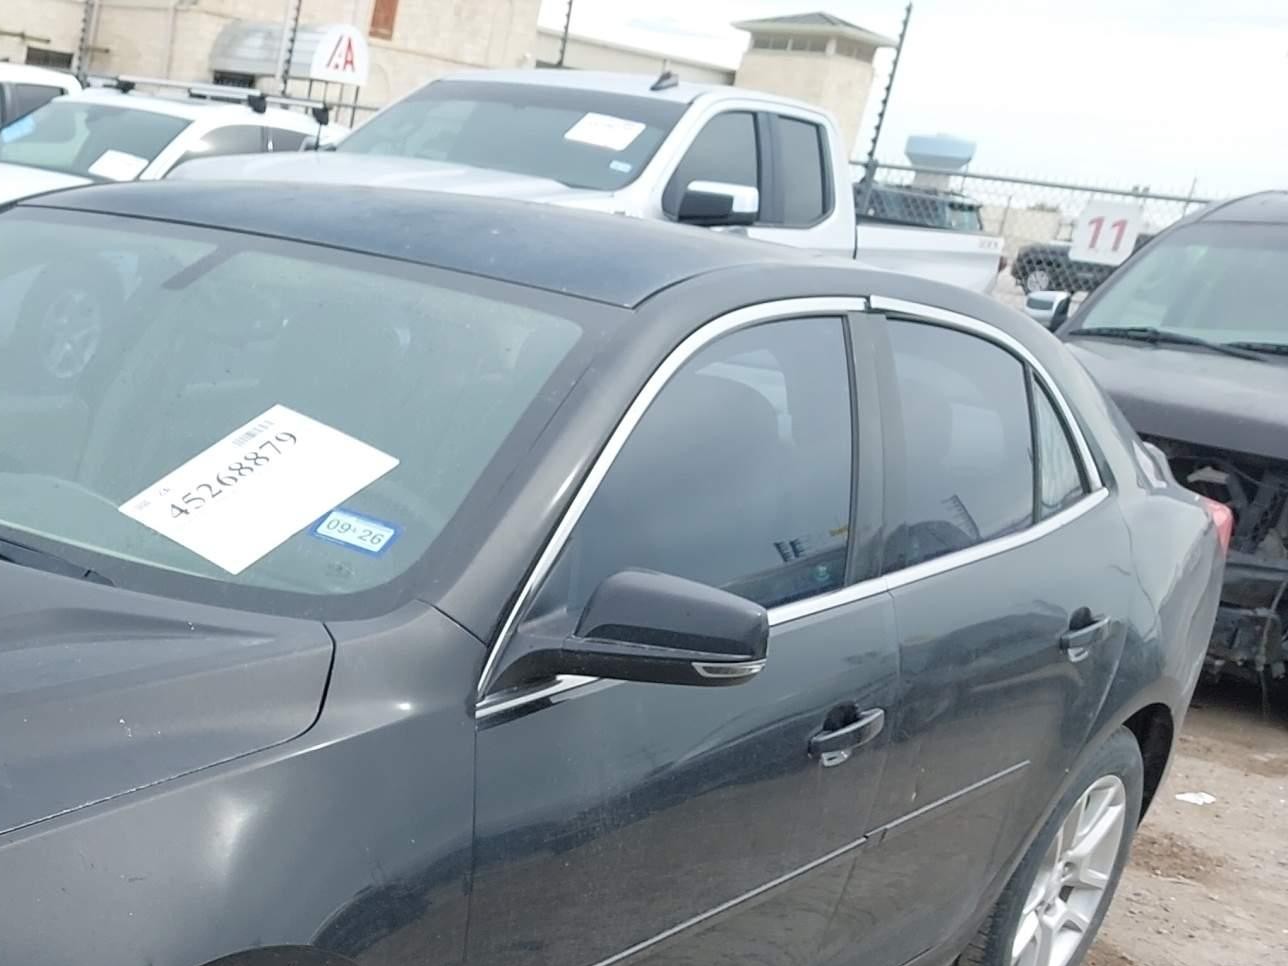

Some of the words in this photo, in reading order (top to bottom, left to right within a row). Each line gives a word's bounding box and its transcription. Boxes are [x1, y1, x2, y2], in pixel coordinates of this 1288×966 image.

[1088, 215, 1128, 252] 11
[170, 431, 297, 519] 45268879
[357, 529, 385, 545] 26
